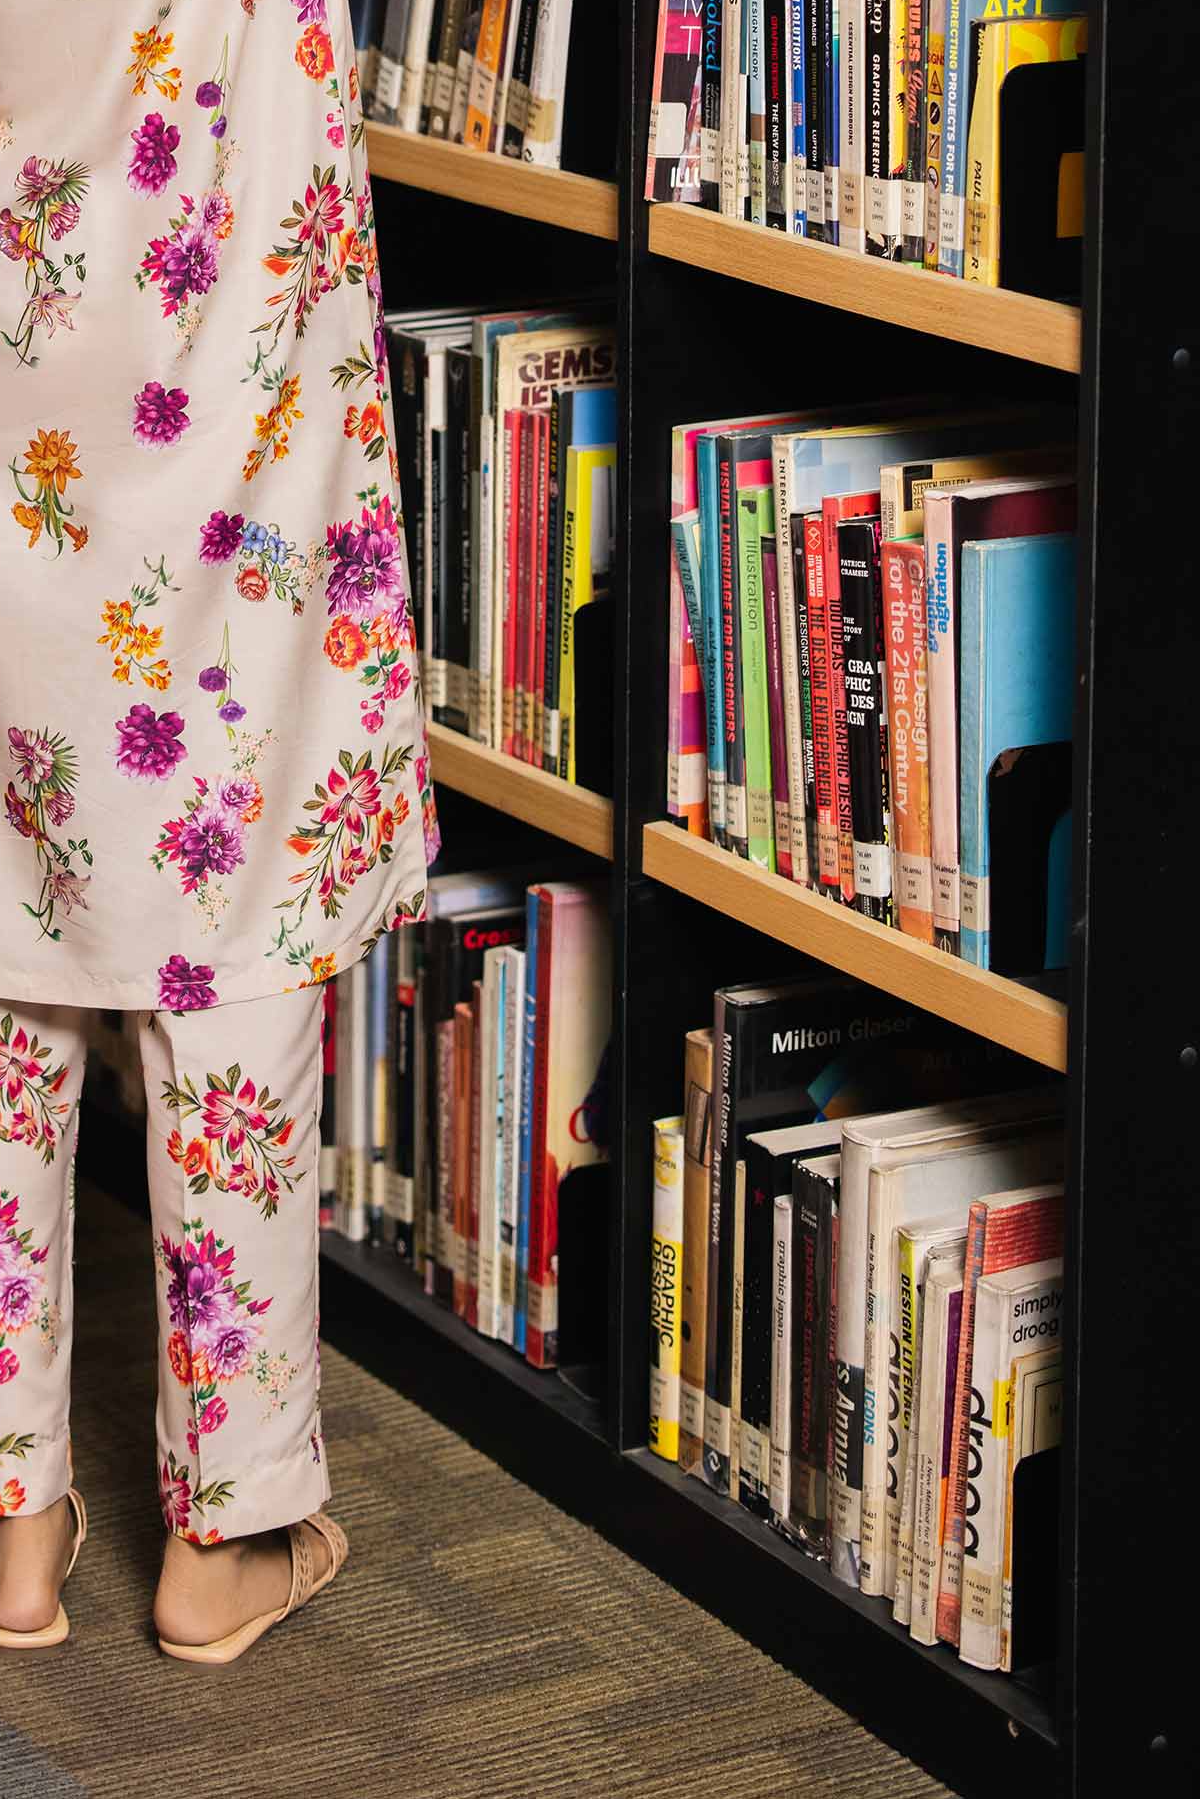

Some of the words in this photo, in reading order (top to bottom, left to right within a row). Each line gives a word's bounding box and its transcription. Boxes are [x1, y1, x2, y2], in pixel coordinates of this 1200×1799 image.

[751, 37, 760, 81] THEORY
[792, 4, 802, 71] SOLUTIONS
[771, 103, 779, 120] THE
[906, 68, 925, 128] Logos
[946, 71, 958, 143] PROJECTS
[771, 121, 779, 142] NEW
[847, 96, 855, 146] HANDBOOKS
[945, 143, 957, 172] FOR
[972, 160, 984, 205] PAUL
[517, 343, 615, 385] GEMS
[718, 460, 730, 520] VISUAL
[564, 509, 575, 570] Berlin
[719, 522, 733, 611] LANGUAGE
[745, 539, 759, 632] Illustration
[840, 558, 867, 570] PATRICK
[841, 567, 869, 578] CRAMSIE
[888, 554, 903, 593] for
[799, 603, 807, 612] A
[830, 598, 842, 623] 100
[935, 542, 950, 635] agitation
[560, 576, 574, 656] Fashion
[722, 613, 734, 648] FOR
[809, 604, 825, 636] THE
[842, 616, 855, 625] THE
[843, 624, 863, 635] STORY
[891, 605, 905, 645] the
[909, 558, 928, 666] Graphic
[800, 614, 810, 677] DESIGNER'S
[831, 625, 845, 672] IDEAS
[843, 634, 852, 643] OF
[811, 637, 827, 691] DESIGN
[844, 677, 871, 692] PHIC
[847, 659, 875, 675] GRA
[892, 648, 910, 704] 21st
[723, 650, 736, 743] DESIGNERS
[802, 678, 812, 737] RESEARCH
[850, 695, 875, 710] DES
[911, 669, 929, 762] Design
[805, 739, 815, 785] MANUAL
[813, 695, 832, 808] ENTREPRENEUR
[893, 706, 912, 815] Century
[721, 1032, 733, 1089] Milton
[771, 1028, 841, 1055] Milton
[720, 1091, 732, 1148] Glaser
[713, 1149, 723, 1179] Art
[712, 1183, 721, 1199] is
[710, 1202, 722, 1244] Work
[776, 1238, 789, 1298] graphic
[659, 1243, 676, 1348] GRAPHIC
[1013, 1288, 1064, 1317] simply
[775, 1299, 787, 1339] japan
[1011, 1318, 1060, 1344] droog
